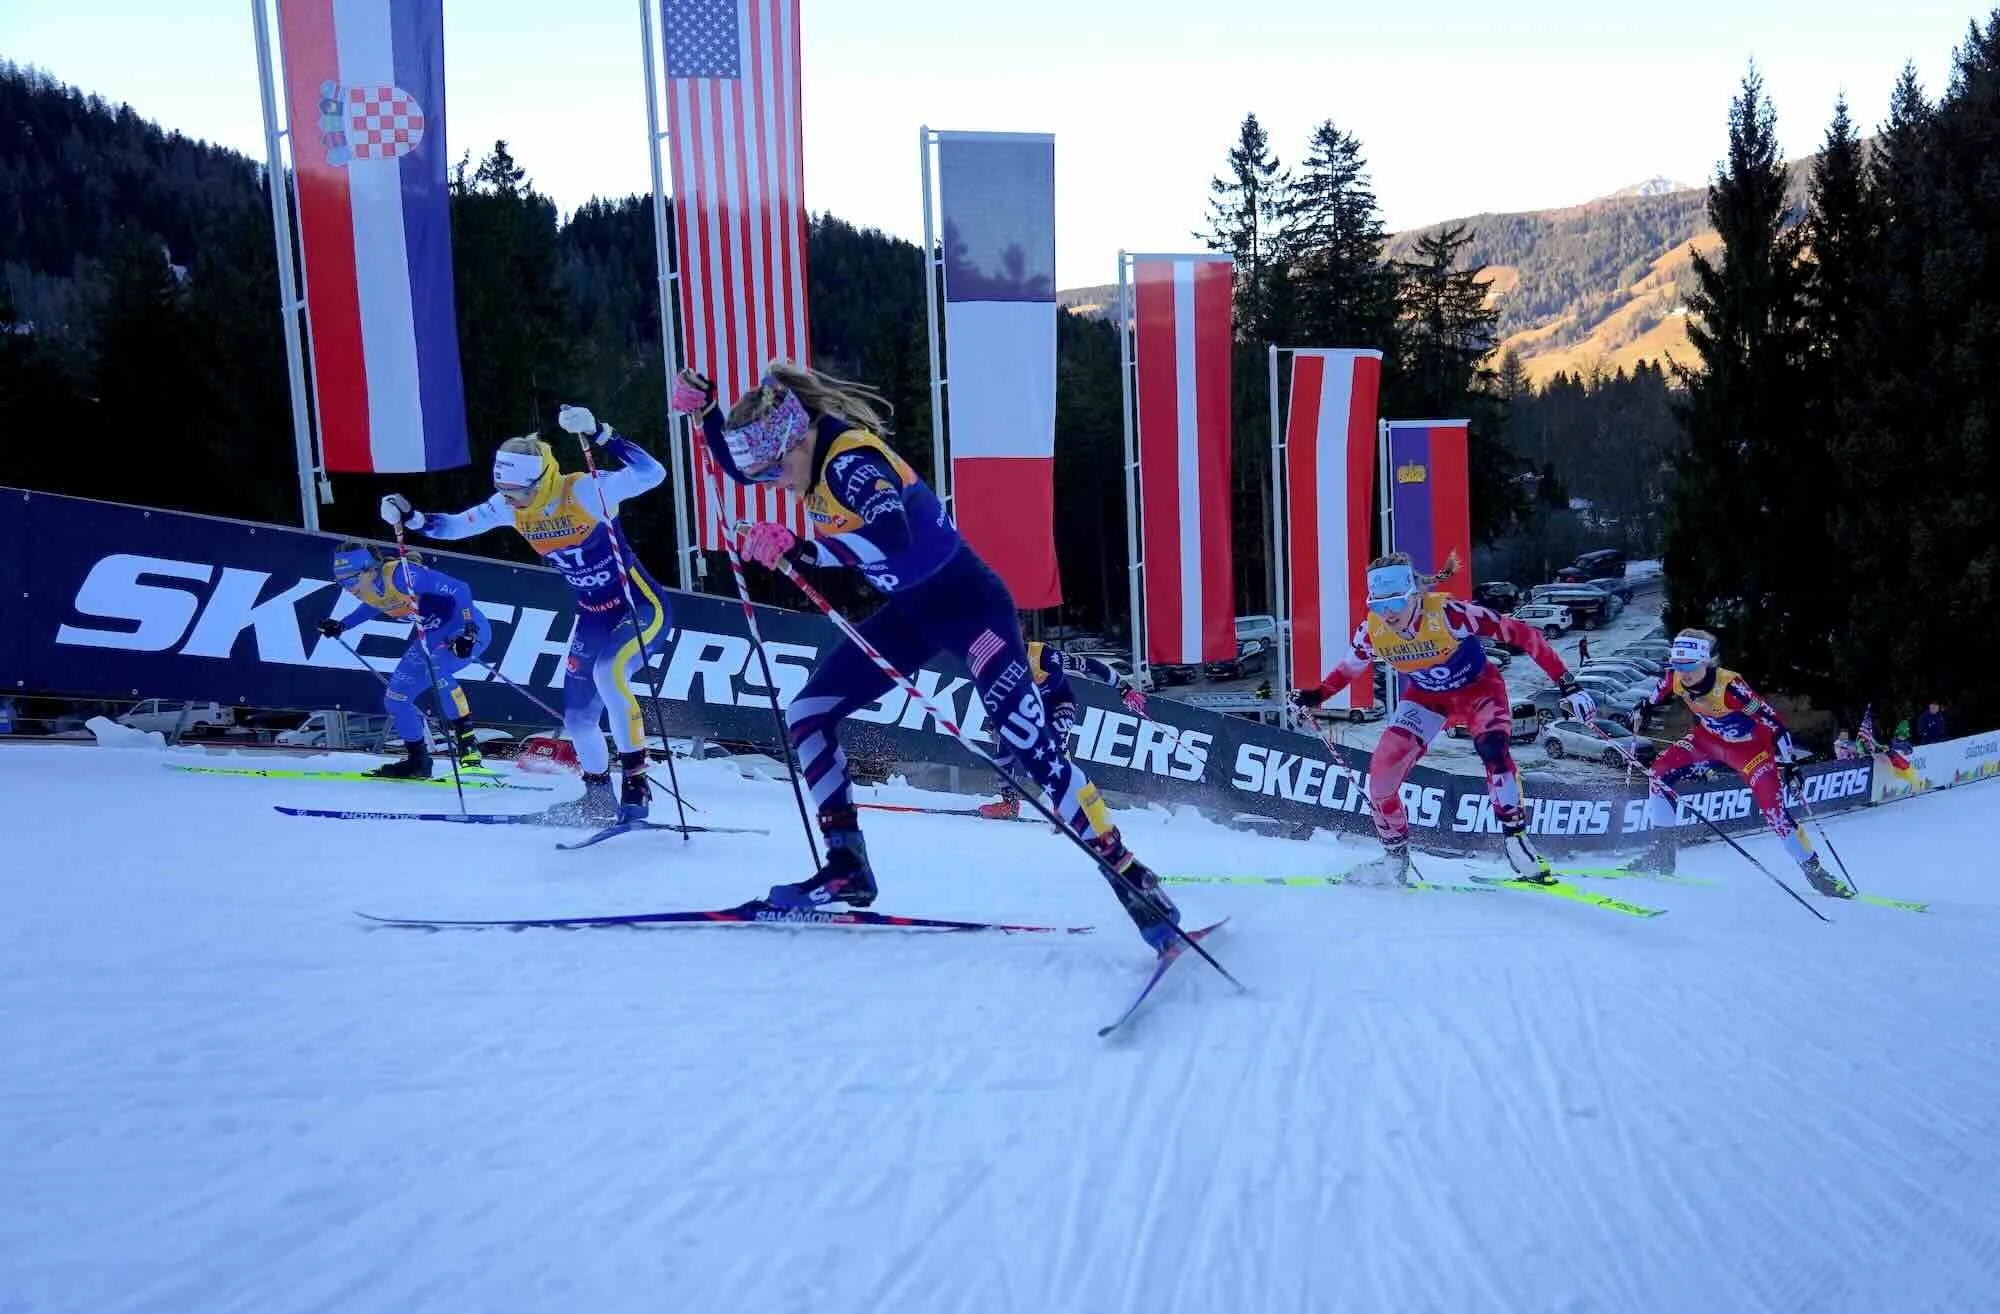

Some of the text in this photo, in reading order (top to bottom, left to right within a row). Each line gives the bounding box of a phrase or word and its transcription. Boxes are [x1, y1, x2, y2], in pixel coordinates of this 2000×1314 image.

[547, 548, 586, 569] 17
[983, 660, 1028, 712] STIFEL
[754, 910, 834, 923] SALOMON
